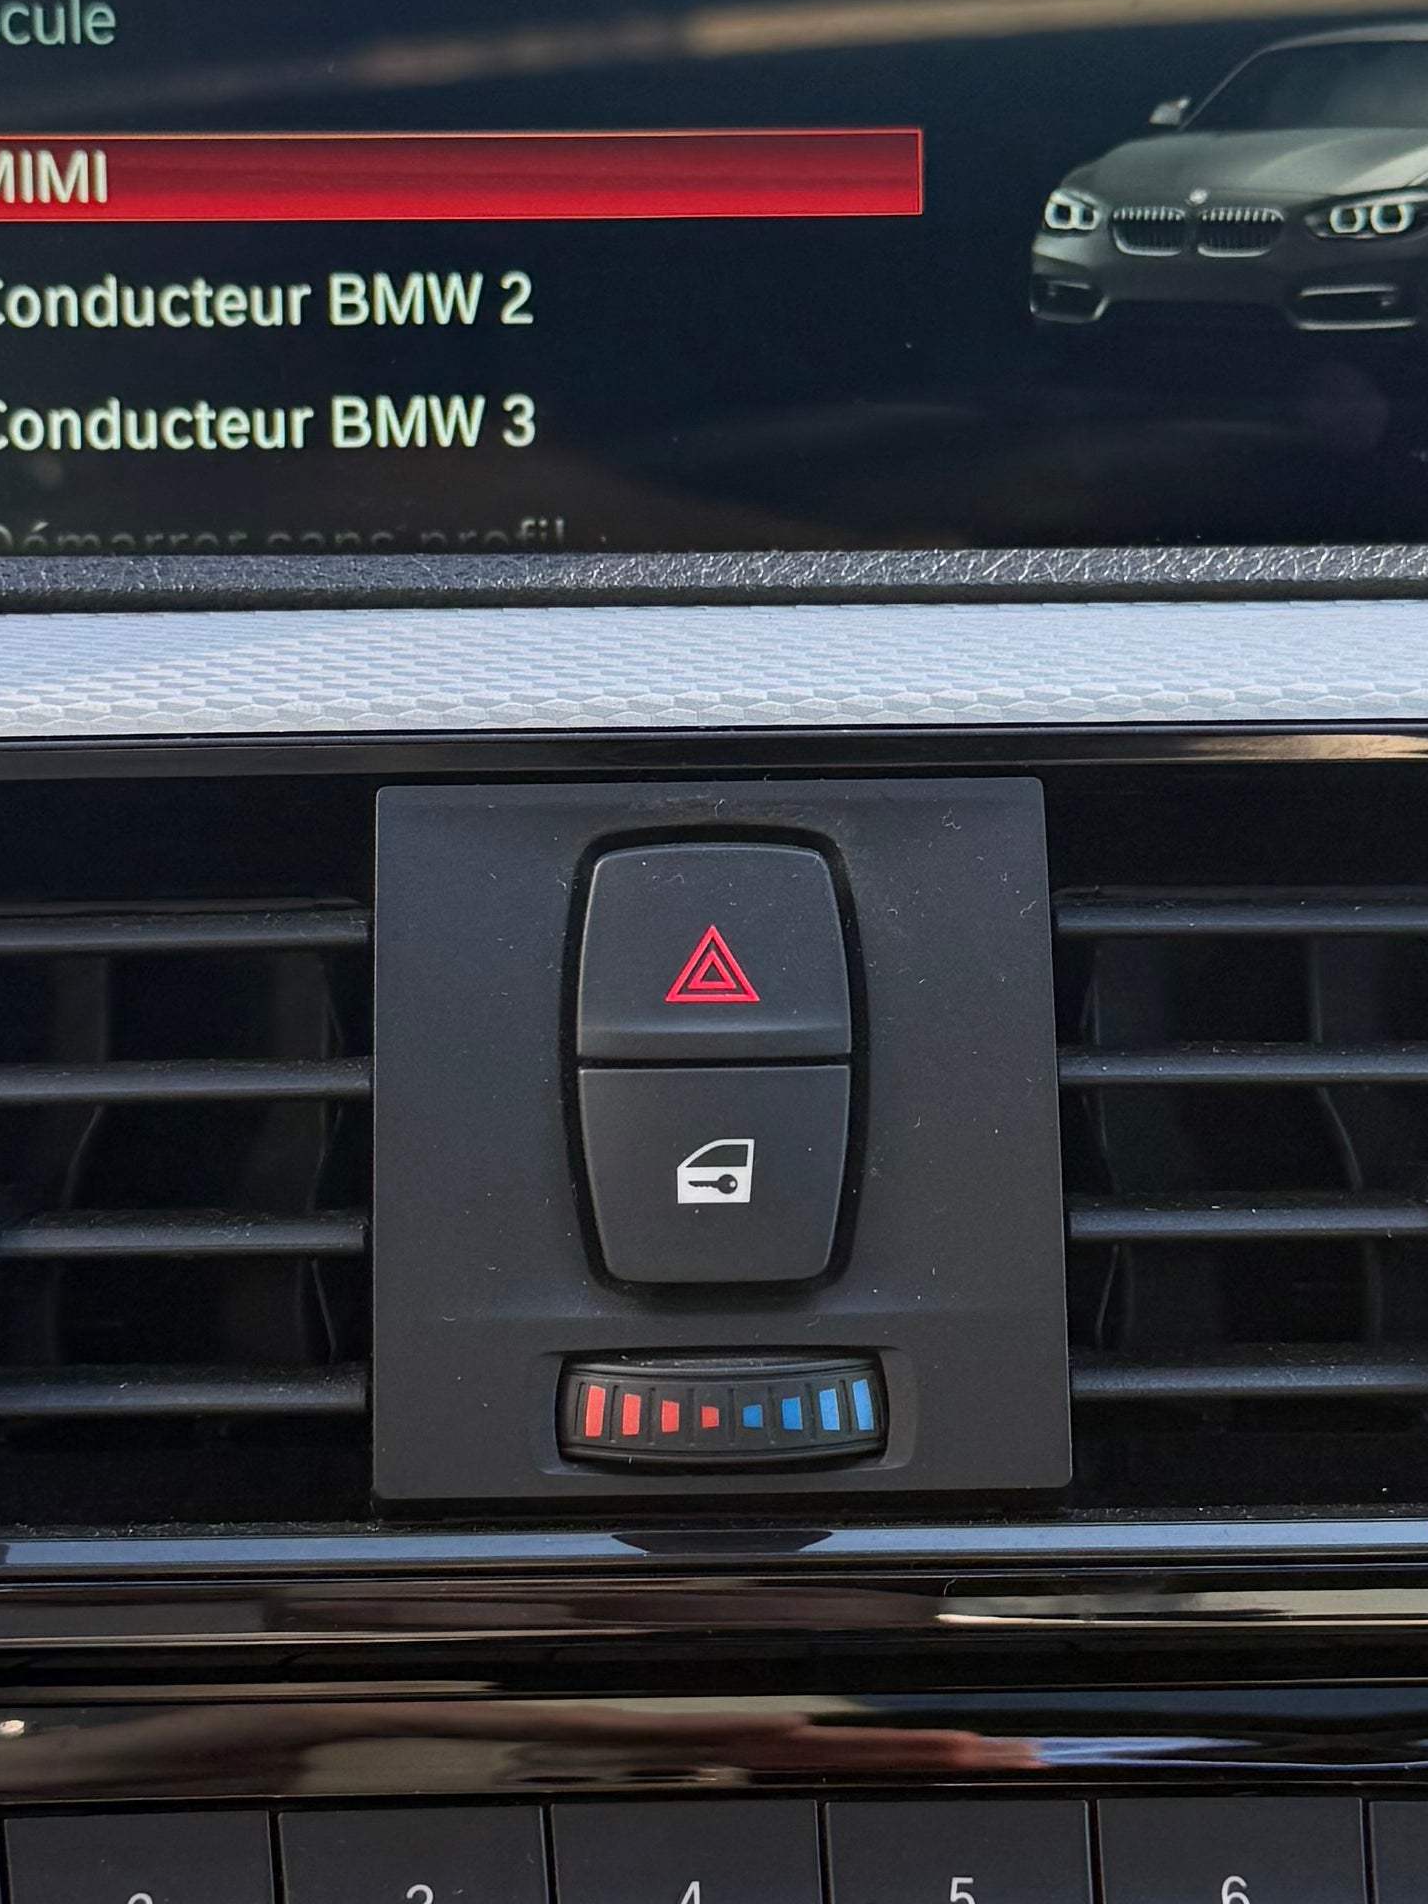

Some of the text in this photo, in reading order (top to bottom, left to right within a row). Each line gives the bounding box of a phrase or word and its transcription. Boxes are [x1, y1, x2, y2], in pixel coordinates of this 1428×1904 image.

[329, 272, 484, 326] BMW
[501, 271, 534, 325] 2
[332, 395, 486, 448] BMW
[503, 394, 536, 447] 3
